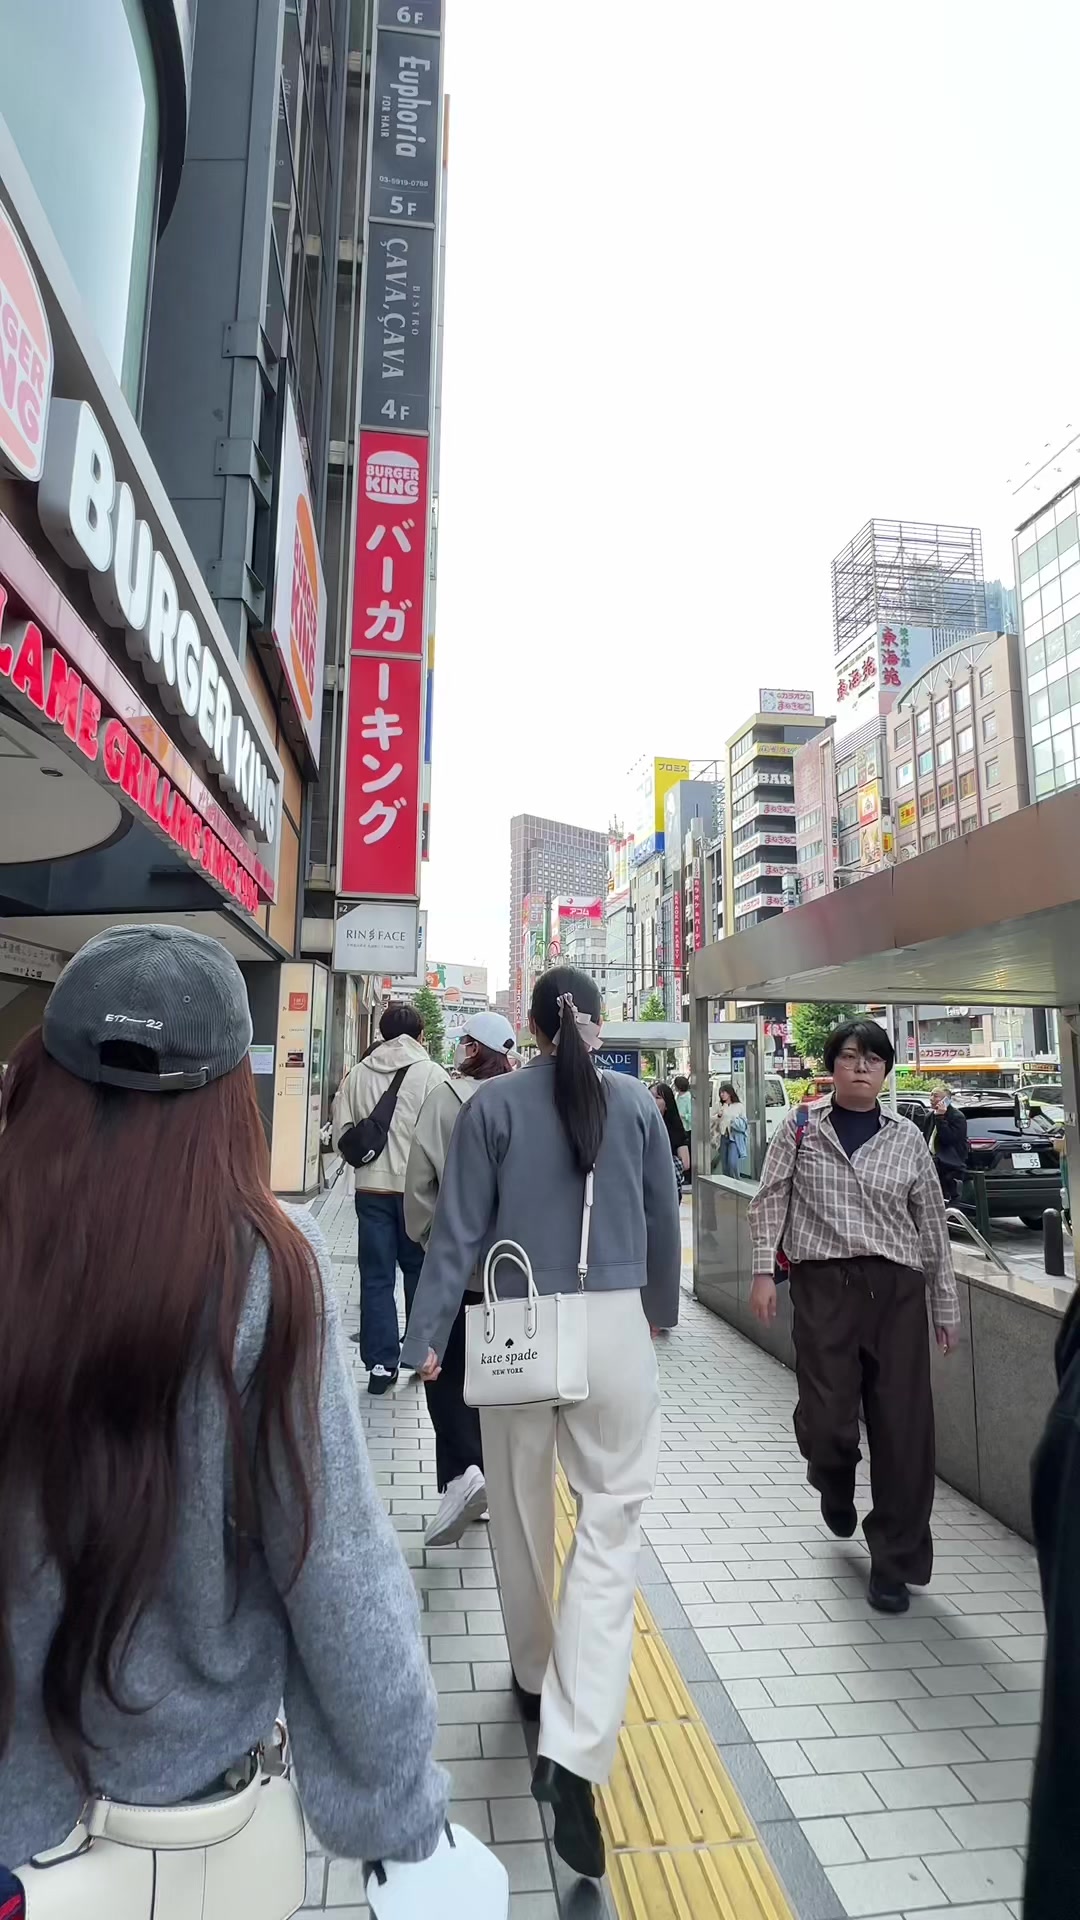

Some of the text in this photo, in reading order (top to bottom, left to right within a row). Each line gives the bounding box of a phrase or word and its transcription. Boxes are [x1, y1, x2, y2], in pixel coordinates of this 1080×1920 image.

[396, 5, 424, 25] 6F
[380, 95, 392, 138] FOR HAIR
[389, 55, 432, 158] Euphoria
[389, 195, 417, 216] 5F
[411, 285, 421, 336] BISTRO
[380, 398, 410, 421] 4F
[366, 464, 420, 481] BURGER
[365, 476, 420, 497] KING
[70, 401, 276, 844] BURGER KING
[657, 762, 688, 773] プロミス
[102, 717, 203, 861] GRILLING
[758, 773, 792, 785] BAR
[569, 907, 590, 916] アコム
[925, 1049, 958, 1057] カラオケ
[480, 1349, 538, 1365] kate spade
[507, 1367, 524, 1375] YORK
